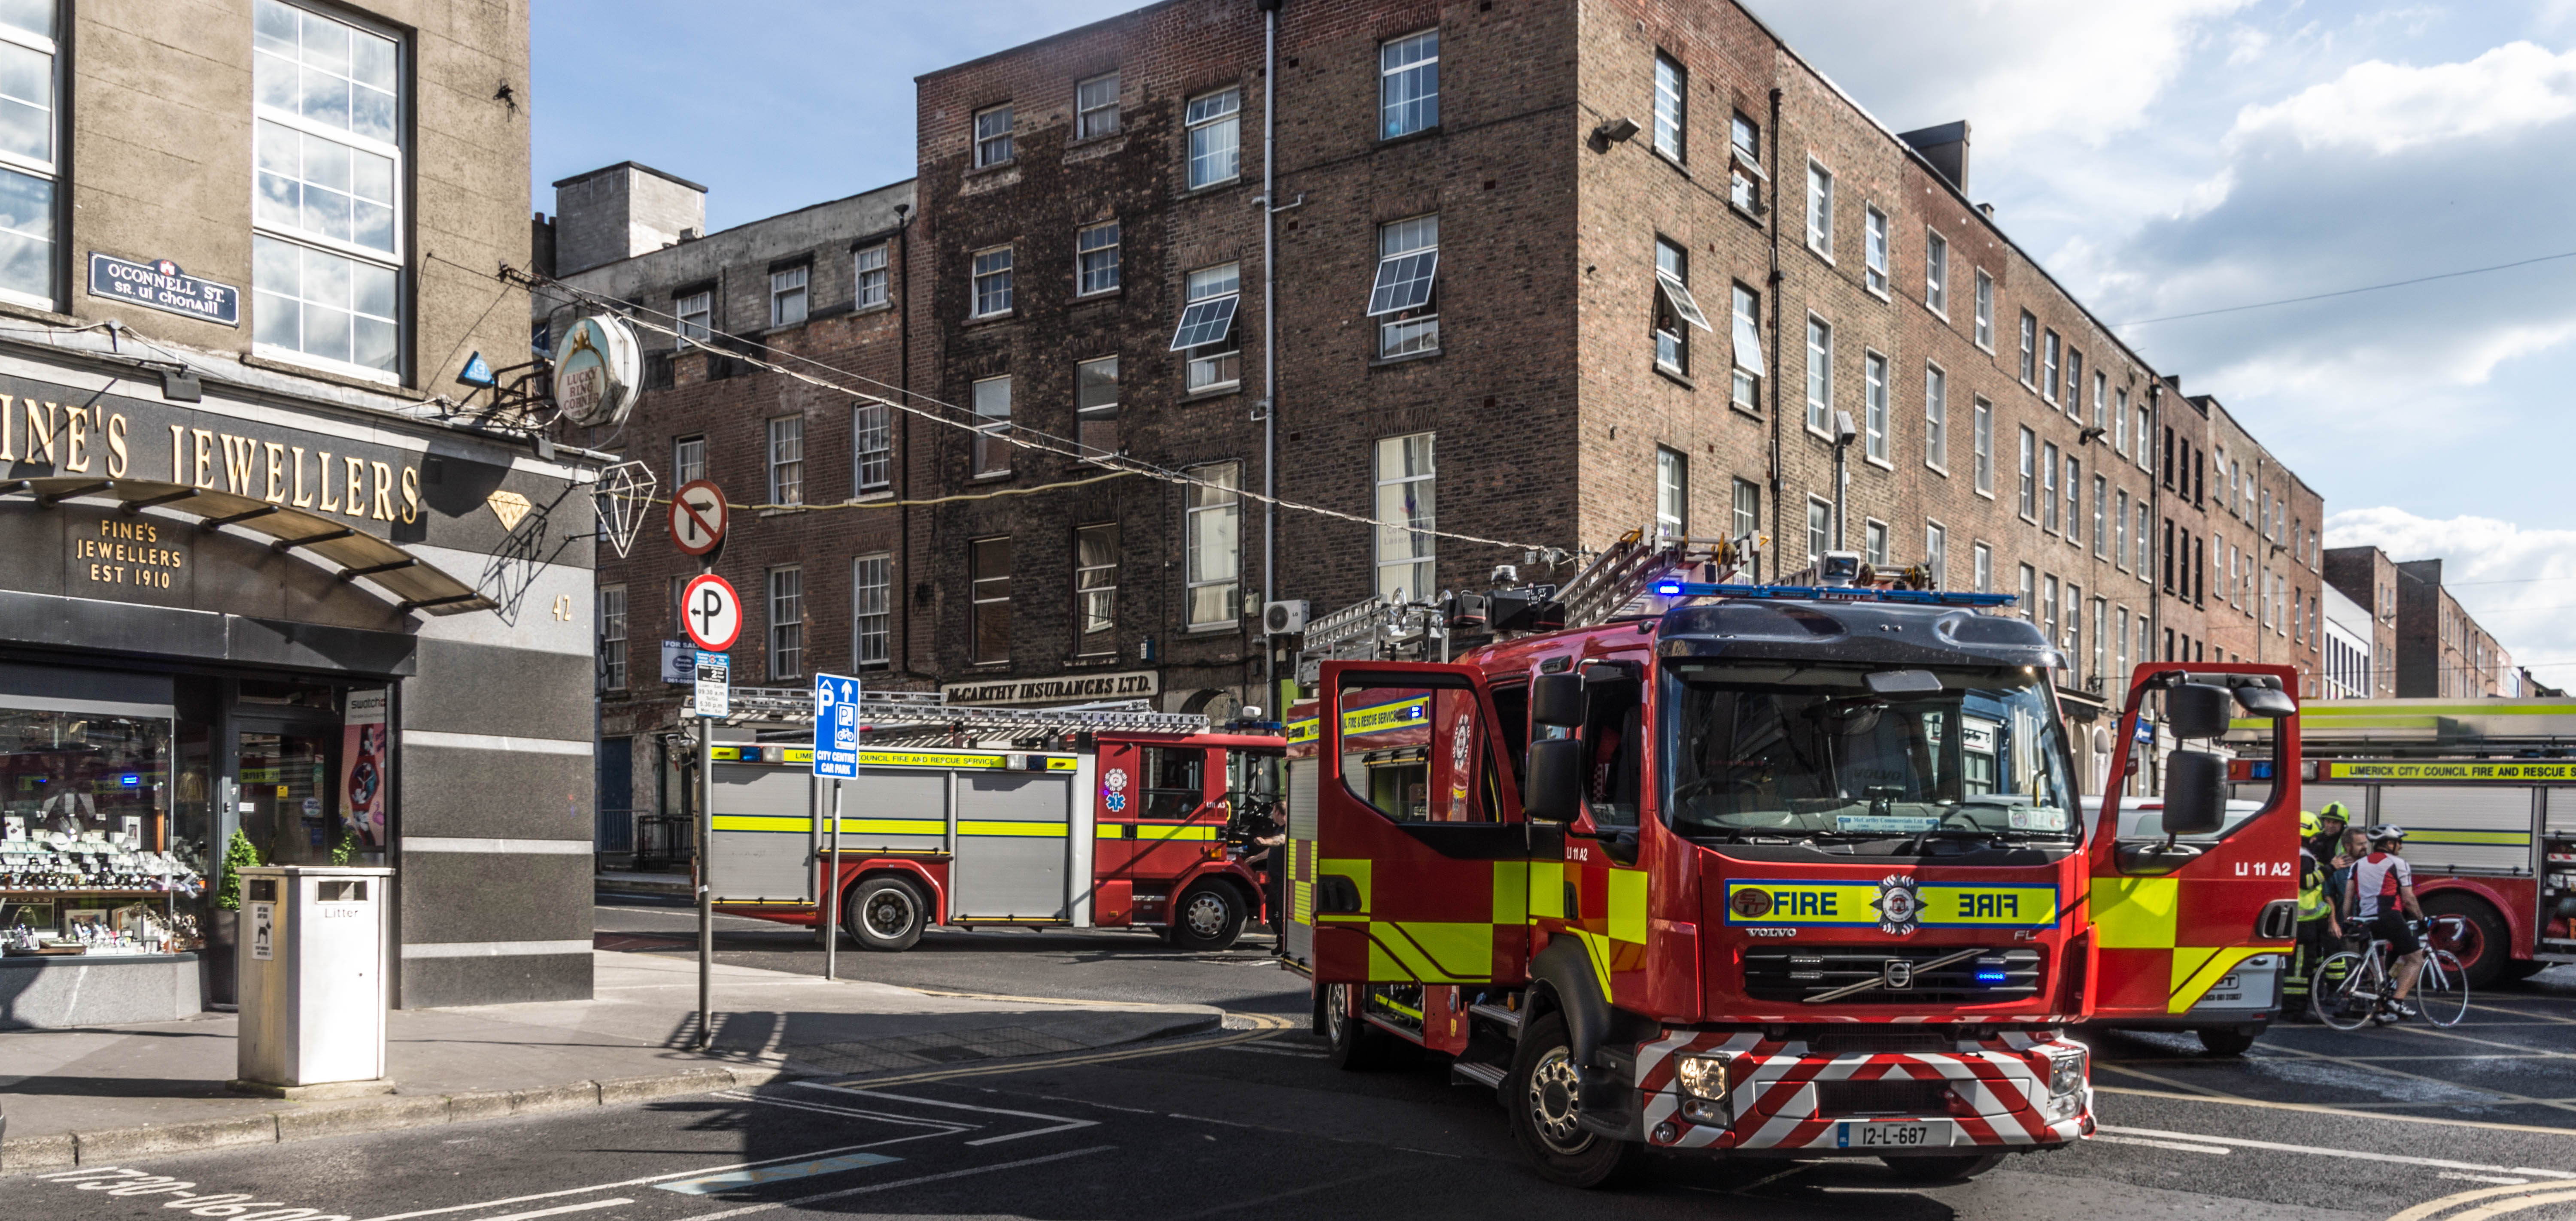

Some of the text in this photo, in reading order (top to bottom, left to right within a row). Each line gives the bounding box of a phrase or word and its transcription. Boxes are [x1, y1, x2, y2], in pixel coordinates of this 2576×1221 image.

[108, 263, 225, 303] O'CONNELL ST.
[567, 367, 597, 385] LUCKY
[569, 382, 593, 397] RING
[564, 393, 599, 410] CORNER
[170, 425, 417, 524] JEWELLERS
[101, 520, 156, 542] FINE'S
[77, 539, 181, 568] JEWELLERS
[1526, 553, 1535, 563] FH
[91, 564, 170, 588] EST 1910
[552, 594, 571, 621] 42
[704, 589, 721, 635] P
[711, 670, 717, 679] 2
[947, 675, 1151, 703] McCARTHY INSURANCES LTD.
[351, 697, 380, 709] swatch
[1348, 718, 1357, 728] FIRE
[1358, 717, 1360, 727] &
[1361, 714, 1377, 727] RESCUE
[1378, 710, 1396, 724] SERVICE
[817, 750, 856, 764] CITY CENTRE
[821, 763, 851, 775] CAR PARK
[2350, 766, 2394, 776] LIMERICK
[2398, 767, 2420, 776] CITY
[2424, 767, 2467, 776] COUNCIL
[2472, 767, 2493, 776] FIRE
[2498, 767, 2519, 776] AND
[2523, 767, 2565, 777] RESCUE
[1579, 848, 1588, 861] A2
[2236, 862, 2291, 876] LI 11 A2
[1774, 892, 1838, 915] FIRE
[325, 908, 358, 918] Litter
[1746, 928, 1797, 937] VOLVO
[2014, 930, 2037, 940] FL
[1862, 1127, 1927, 1145] 12-L-687
